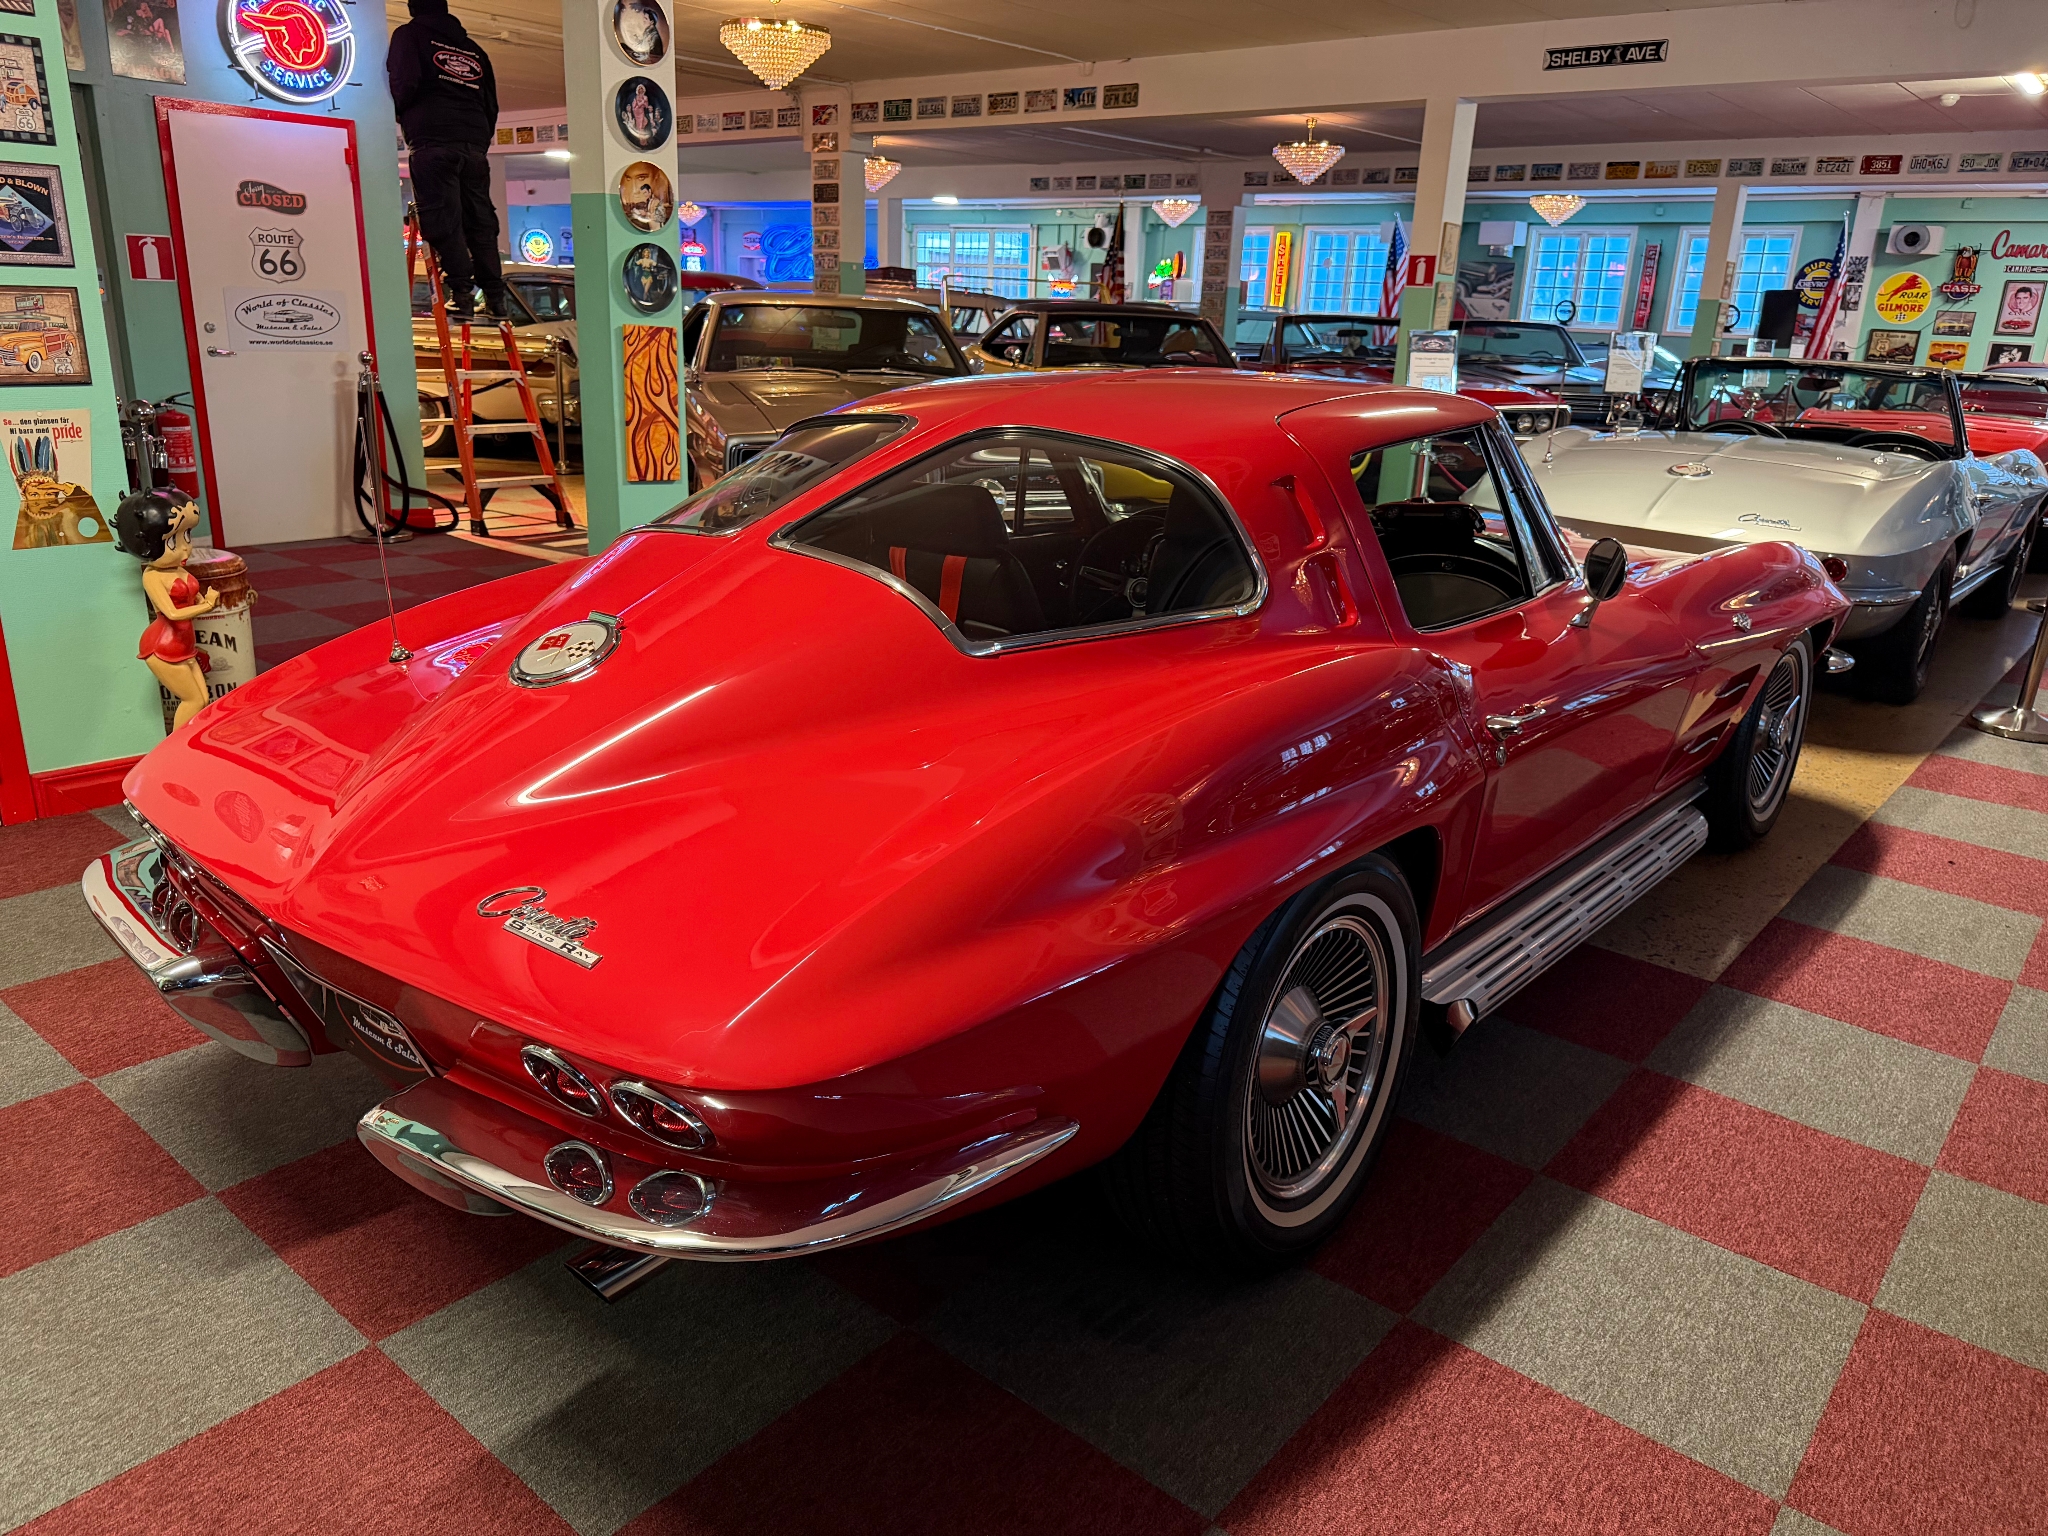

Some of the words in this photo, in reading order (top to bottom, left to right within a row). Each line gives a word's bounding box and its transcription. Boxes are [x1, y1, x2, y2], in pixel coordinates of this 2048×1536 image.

[1551, 49, 1612, 66] SHELBY
[1625, 45, 1658, 60] AVE.
[262, 60, 333, 89] SERVICE
[18, 118, 34, 130] 66
[1870, 159, 1892, 169] 3851
[1960, 159, 1975, 168] 450
[15, 178, 49, 196] BLOWN
[240, 193, 304, 208] CLOSED
[258, 234, 294, 244] ROUTE
[1991, 230, 2048, 260] Camar
[260, 248, 298, 275] 66
[1804, 261, 1833, 275] SUPE
[2006, 265, 2032, 273] CAMARO
[1942, 284, 1978, 293] CASE
[241, 299, 273, 315] World
[291, 298, 334, 317] Classics
[1878, 303, 1924, 313] GILMORE
[33, 417, 59, 426] glansen
[60, 416, 70, 424] får
[10, 427, 17, 435] Ni
[19, 427, 34, 435] bara
[52, 421, 83, 450] pride
[195, 629, 238, 653] EAM
[352, 1015, 385, 1045] Museum
[386, 1037, 394, 1050] &
[394, 1043, 421, 1065] Sales
